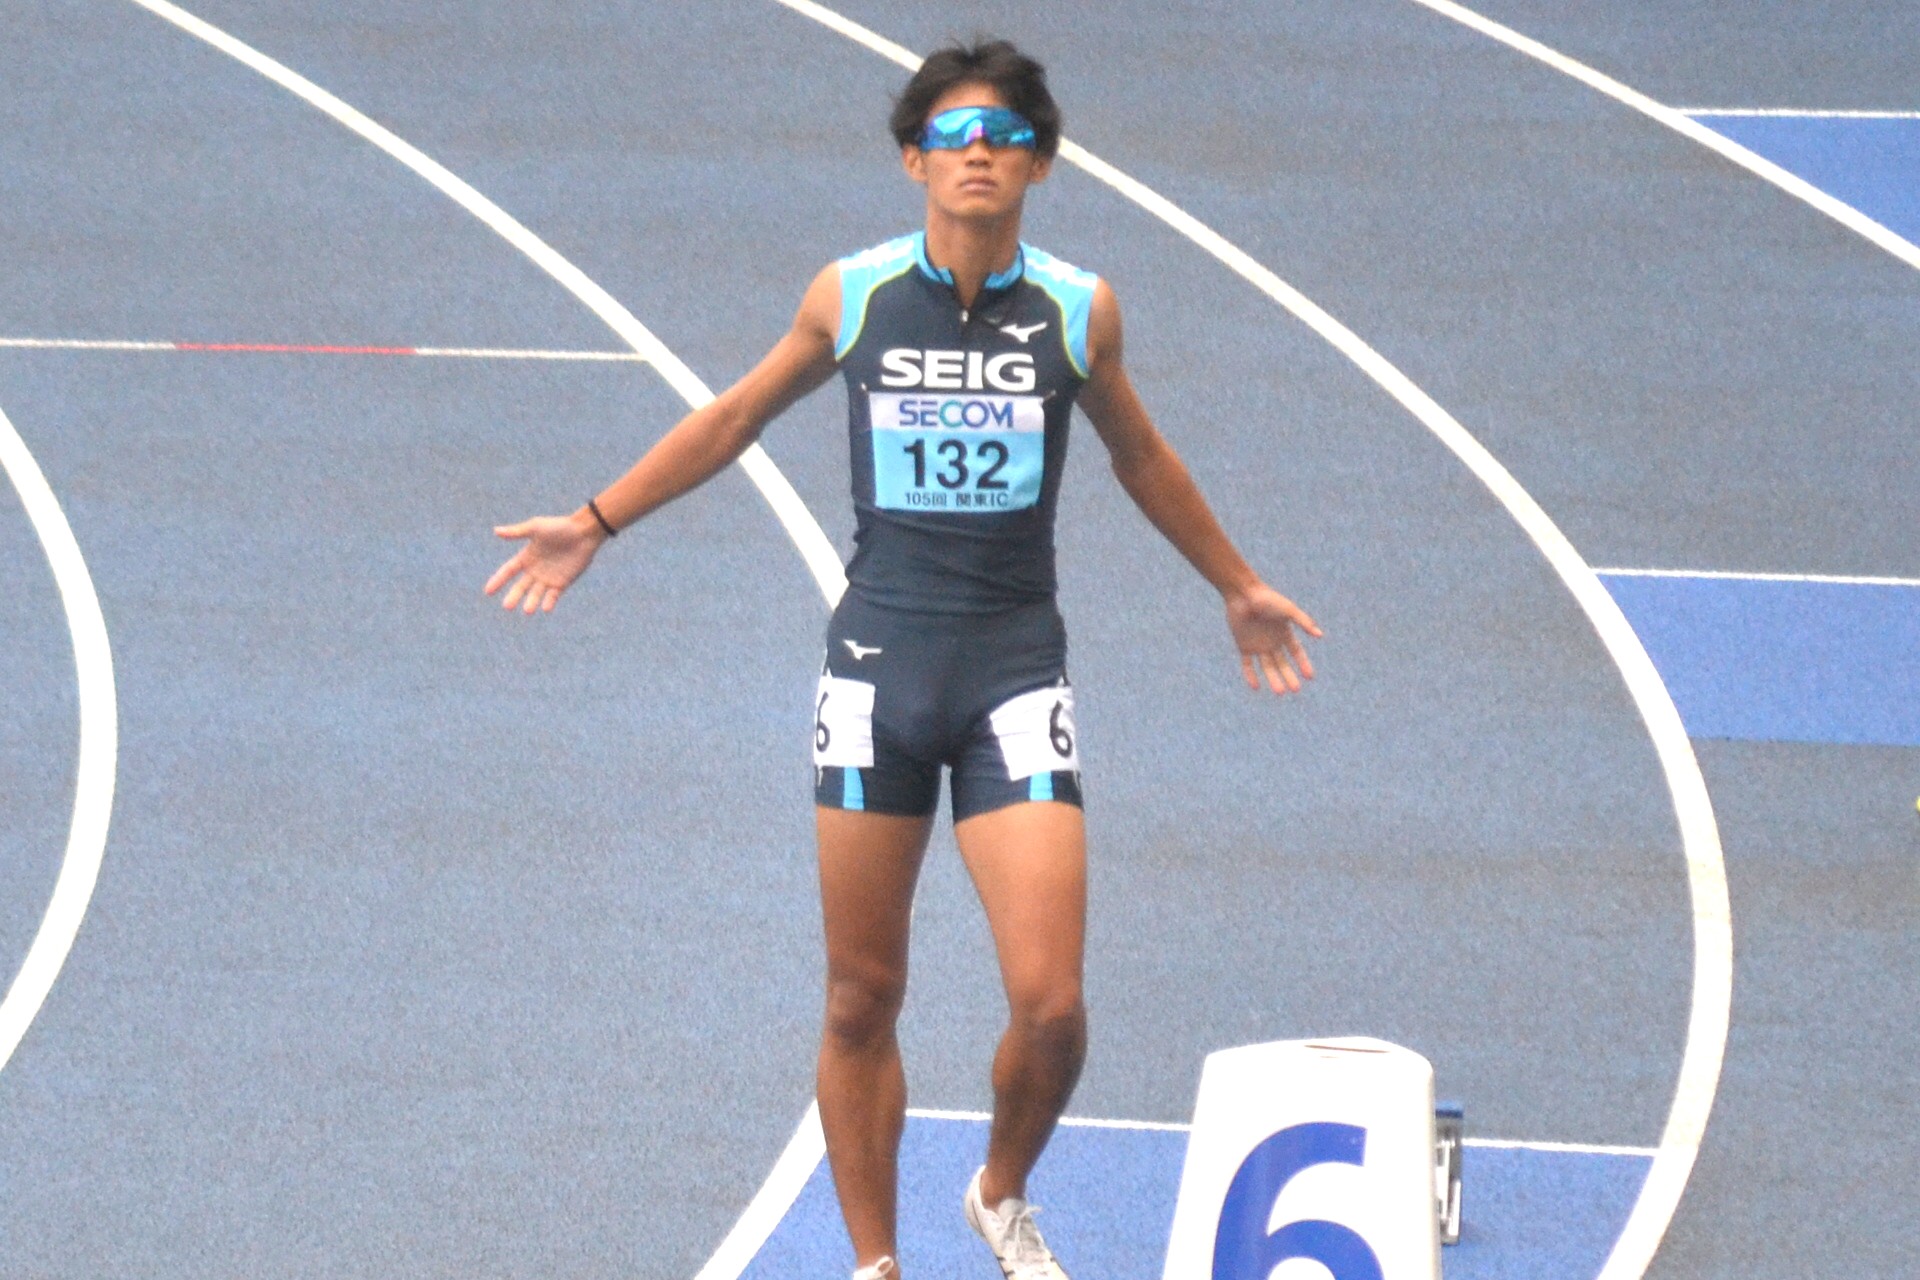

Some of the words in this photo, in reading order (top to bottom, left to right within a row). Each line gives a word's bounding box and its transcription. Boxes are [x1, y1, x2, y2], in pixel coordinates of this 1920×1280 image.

[881, 348, 1036, 392] SEIG
[899, 400, 1014, 428] SECOM
[903, 438, 1009, 489] 132
[816, 691, 830, 753] 6
[1049, 699, 1073, 758] 6
[1210, 1121, 1386, 1280] 6
